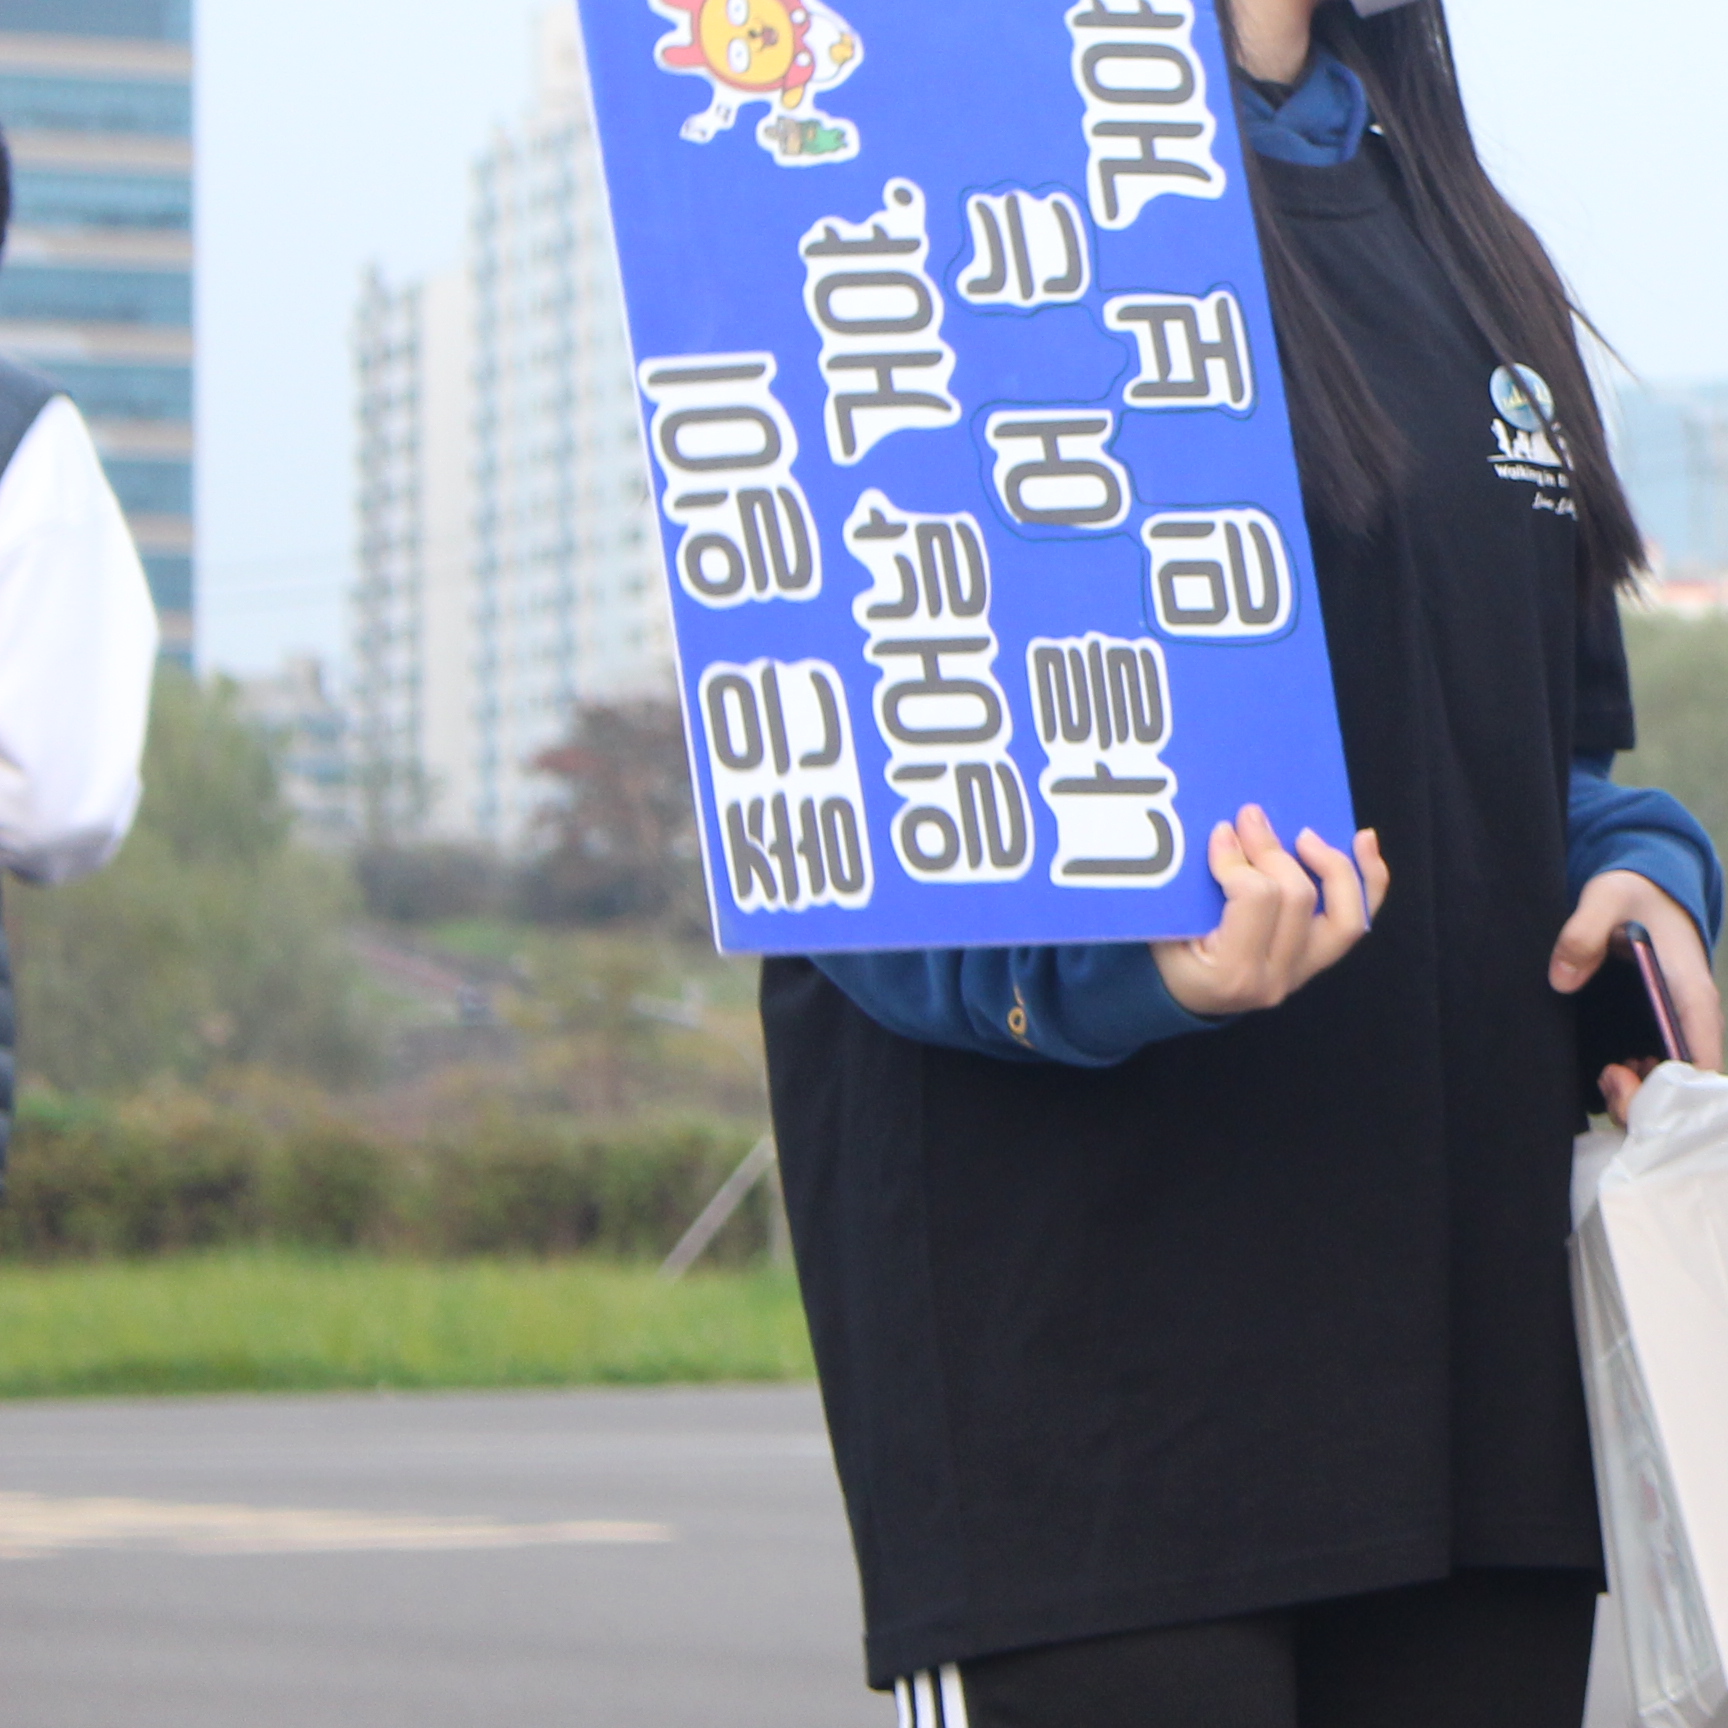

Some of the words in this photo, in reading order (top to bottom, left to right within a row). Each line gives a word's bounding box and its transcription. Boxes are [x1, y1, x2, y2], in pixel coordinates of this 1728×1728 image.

[803, 186, 951, 459] 거야.
[647, 362, 811, 598] 일이
[696, 668, 864, 914] 좋은
[842, 488, 1034, 883] 일어날
[1032, 640, 1175, 878] 나를
